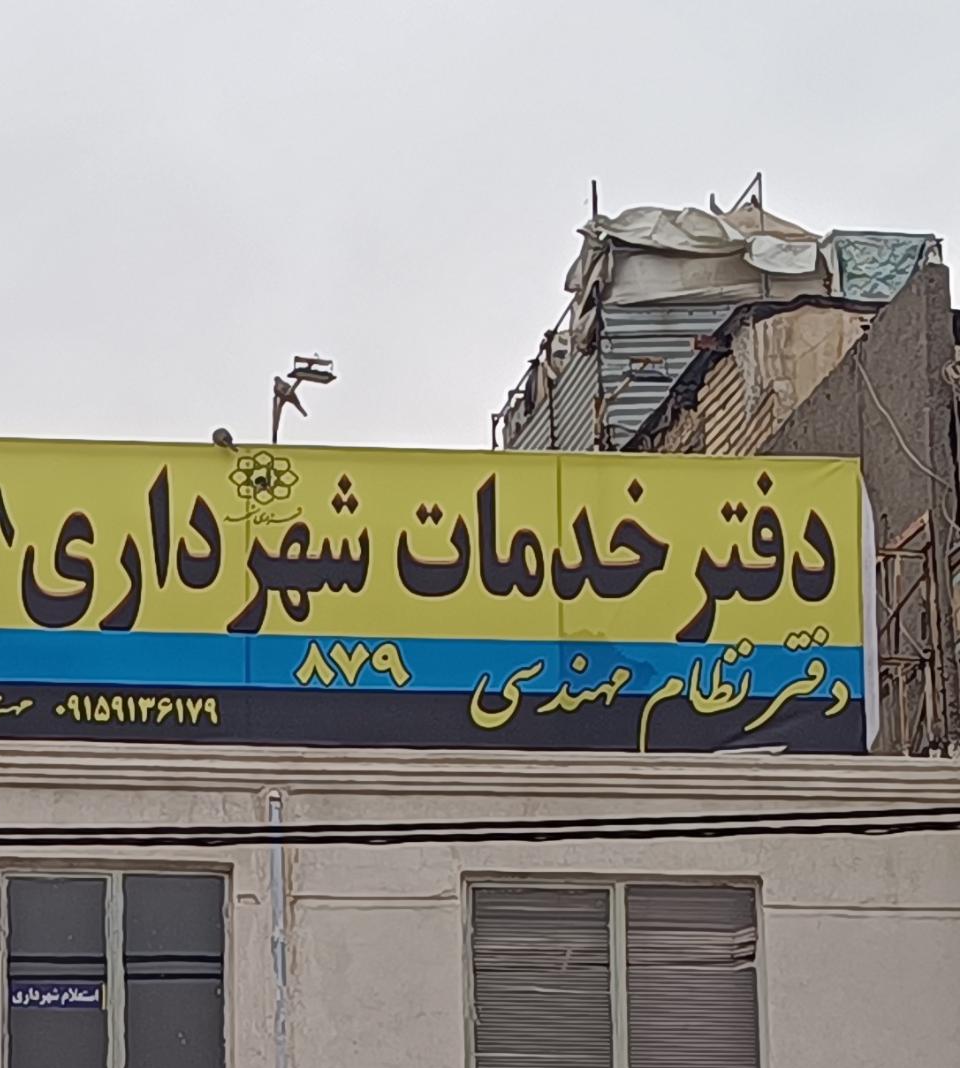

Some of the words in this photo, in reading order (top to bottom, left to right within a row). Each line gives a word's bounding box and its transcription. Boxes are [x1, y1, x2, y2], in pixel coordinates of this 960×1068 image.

[20, 465, 370, 636] شهرداری
[396, 473, 669, 602] خدمات
[676, 471, 836, 643] دفتر
[54, 693, 219, 725] ۰۹۱۵۹۱۳۶۱۷۹
[293, 639, 411, 688] ۸۷۹
[470, 654, 633, 730] مهندسی
[641, 638, 752, 753] نظام
[744, 626, 849, 733] دفتر
[11, 987, 60, 1006] شهرداری
[60, 987, 99, 1005] استعلام
